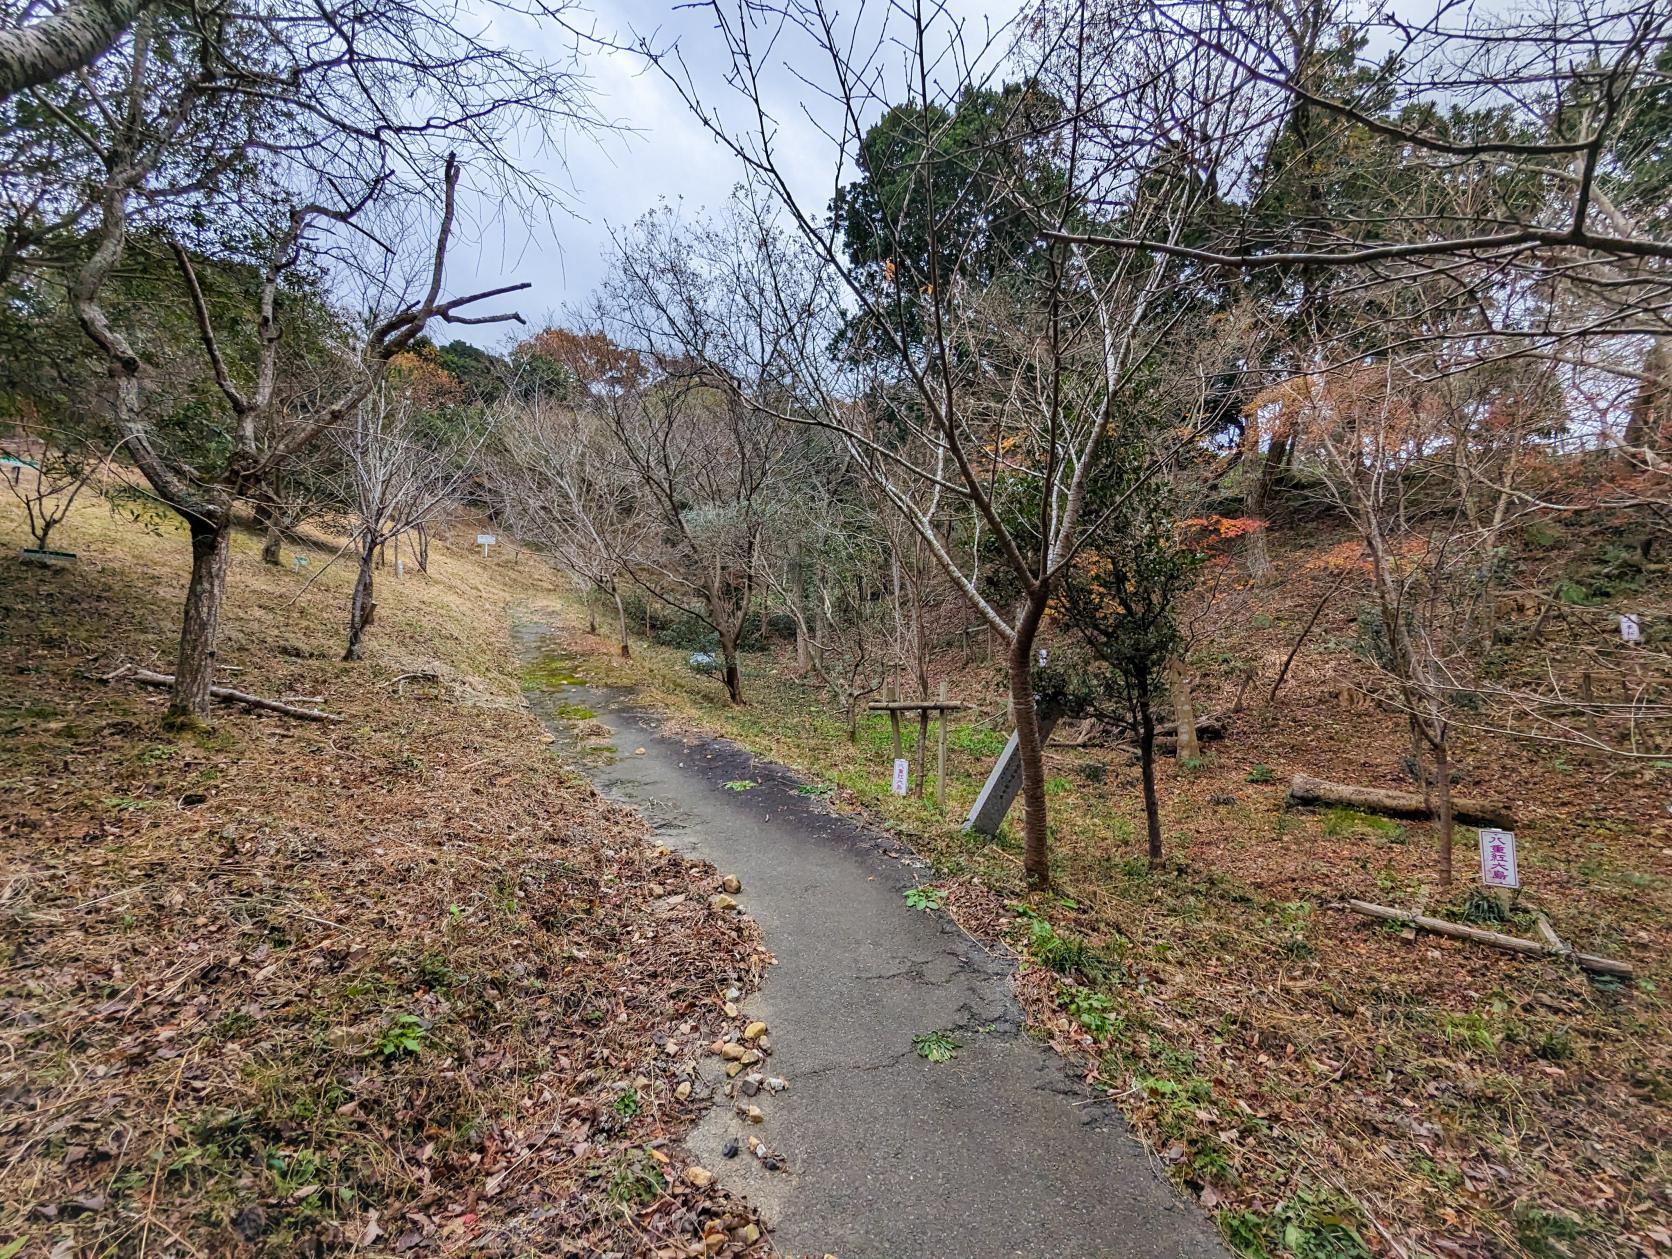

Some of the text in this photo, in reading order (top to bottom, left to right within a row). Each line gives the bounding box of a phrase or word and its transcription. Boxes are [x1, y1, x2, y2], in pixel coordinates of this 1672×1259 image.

[1489, 836, 1509, 880] 八重紅大島
